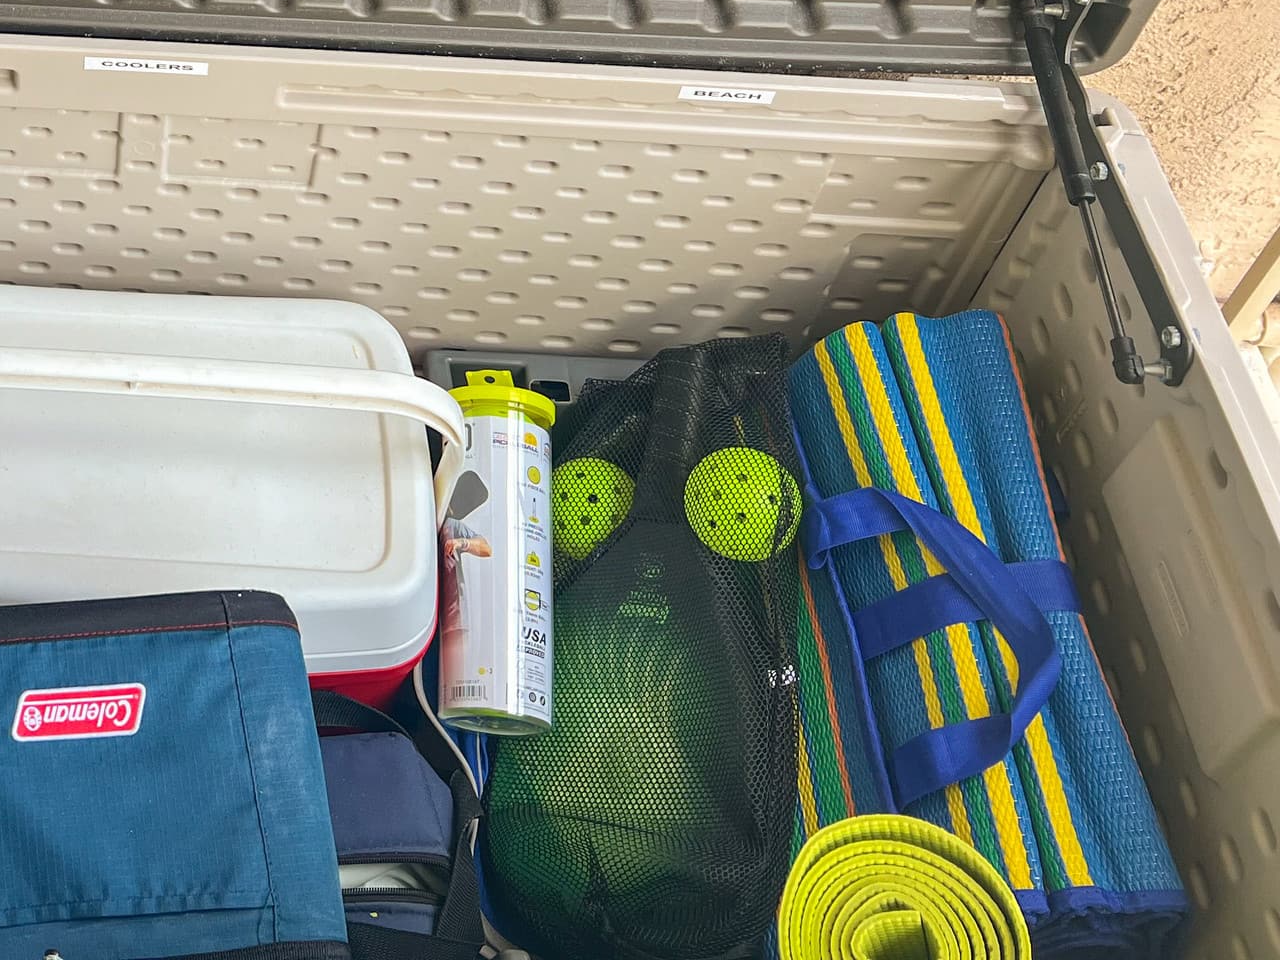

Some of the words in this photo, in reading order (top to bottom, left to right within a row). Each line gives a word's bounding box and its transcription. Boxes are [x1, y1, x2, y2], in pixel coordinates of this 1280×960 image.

[101, 60, 194, 72] COOLERS
[693, 90, 762, 100] BEACH
[523, 625, 547, 646] USA
[43, 699, 132, 728] Coleman
